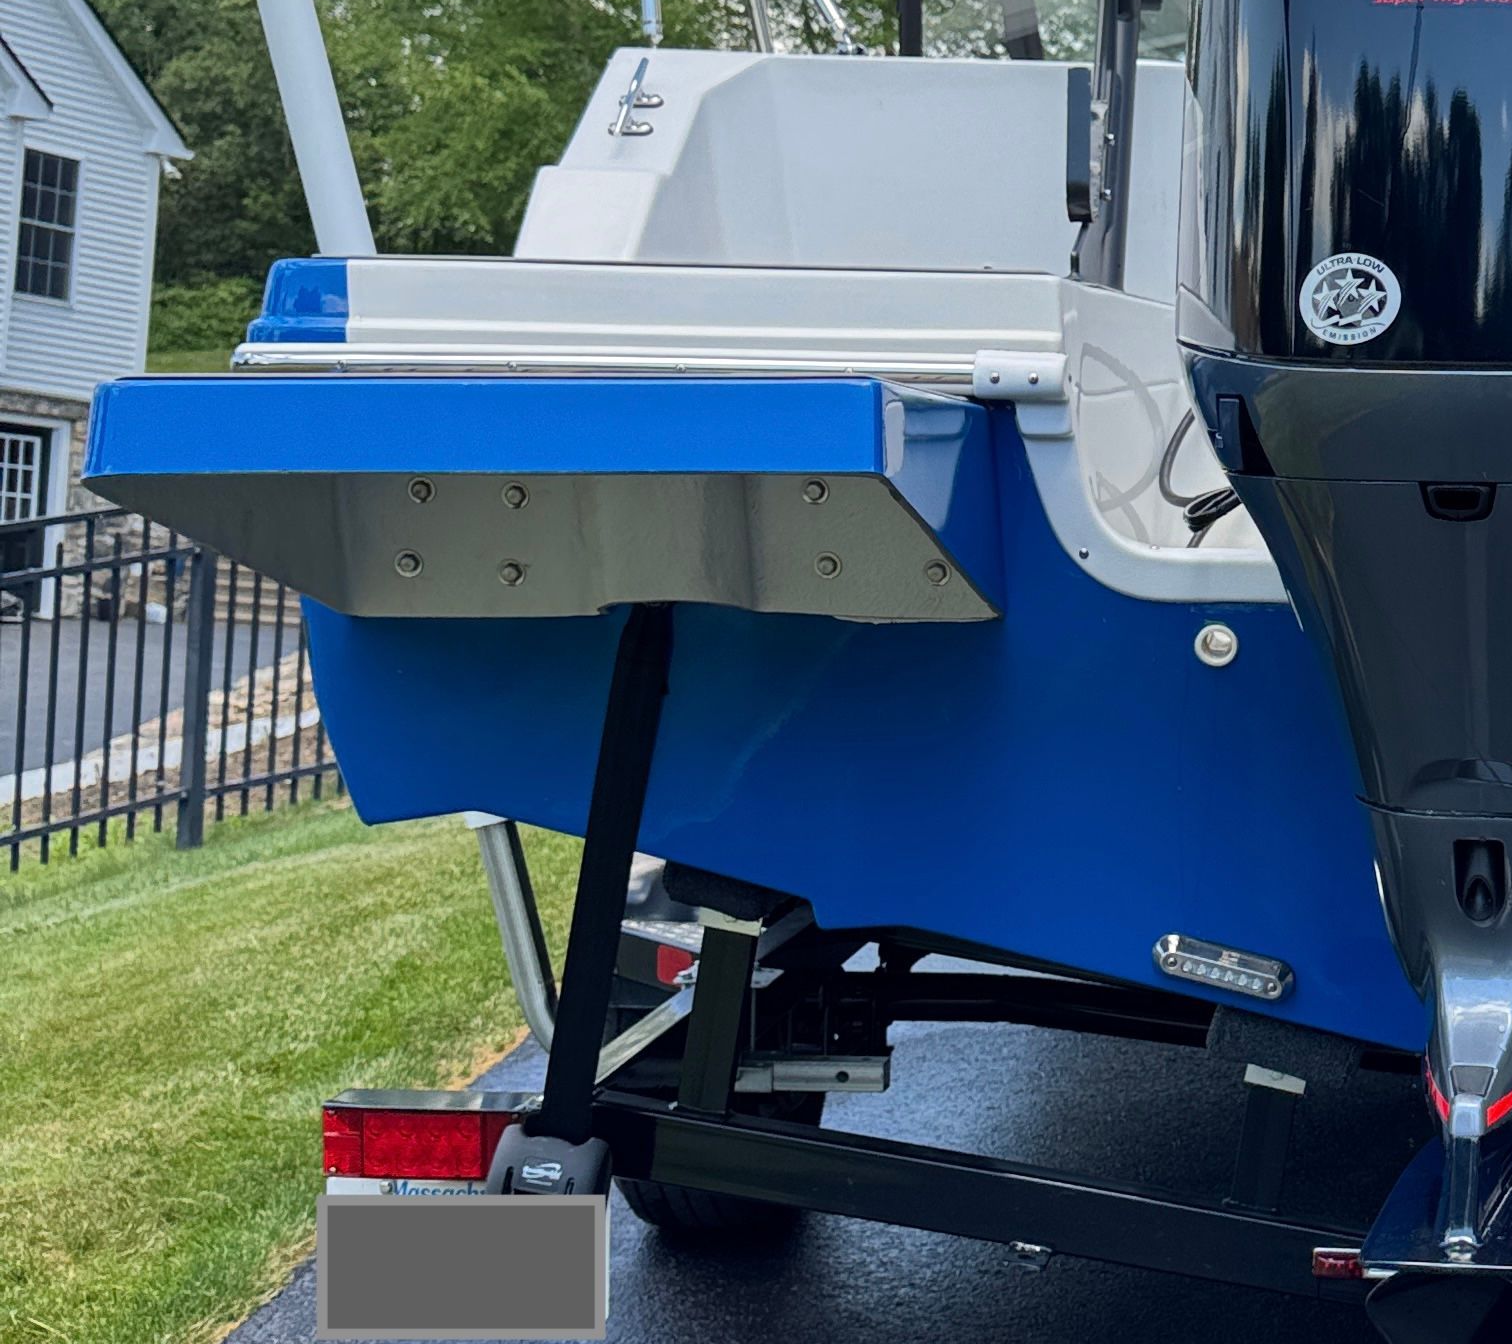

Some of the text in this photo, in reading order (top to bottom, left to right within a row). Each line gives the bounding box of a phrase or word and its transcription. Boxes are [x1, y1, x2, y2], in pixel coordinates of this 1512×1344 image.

[1316, 256, 1386, 276] ULTRA LOW
[1322, 326, 1377, 342] EMISSION
